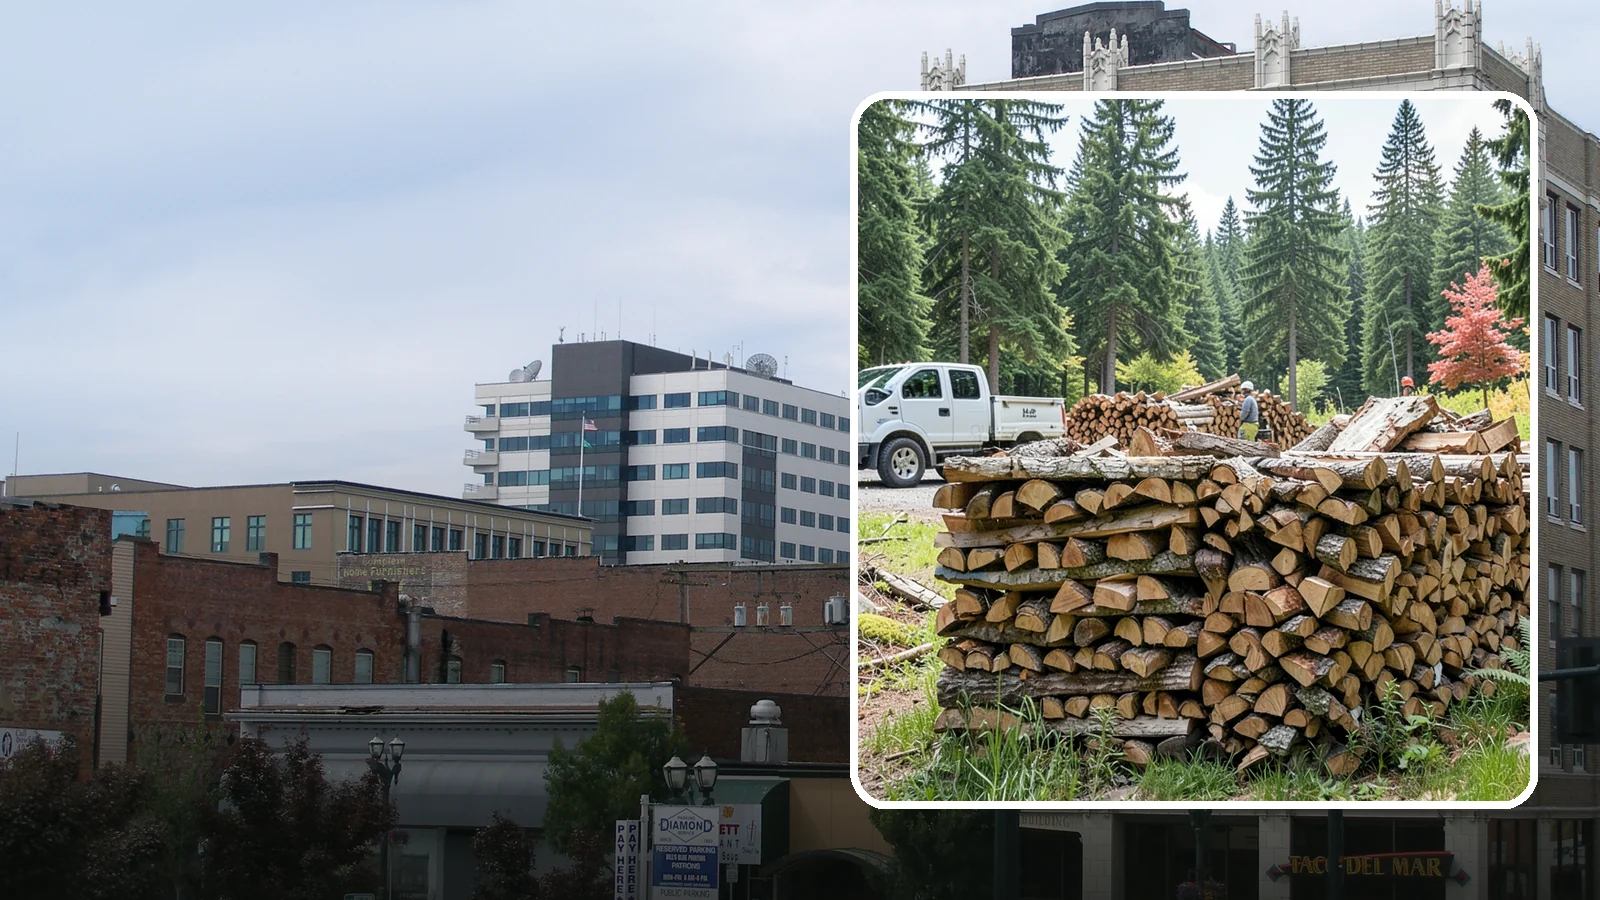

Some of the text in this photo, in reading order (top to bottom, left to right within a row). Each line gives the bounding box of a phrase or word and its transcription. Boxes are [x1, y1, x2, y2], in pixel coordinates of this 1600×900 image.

[343, 566, 426, 577] Home Furnishers
[660, 818, 713, 832] DIAMOND
[1022, 815, 1070, 828] BUILDING
[656, 845, 716, 854] RESERVED PARKING
[616, 825, 625, 893] PAY HERE
[627, 825, 637, 893] PAY HERE
[722, 851, 739, 862] Soup
[672, 862, 701, 870] PATRONS
[1346, 856, 1385, 875] DEL
[1392, 858, 1442, 877] MAR
[661, 889, 710, 898] PUBLIC PARKING
